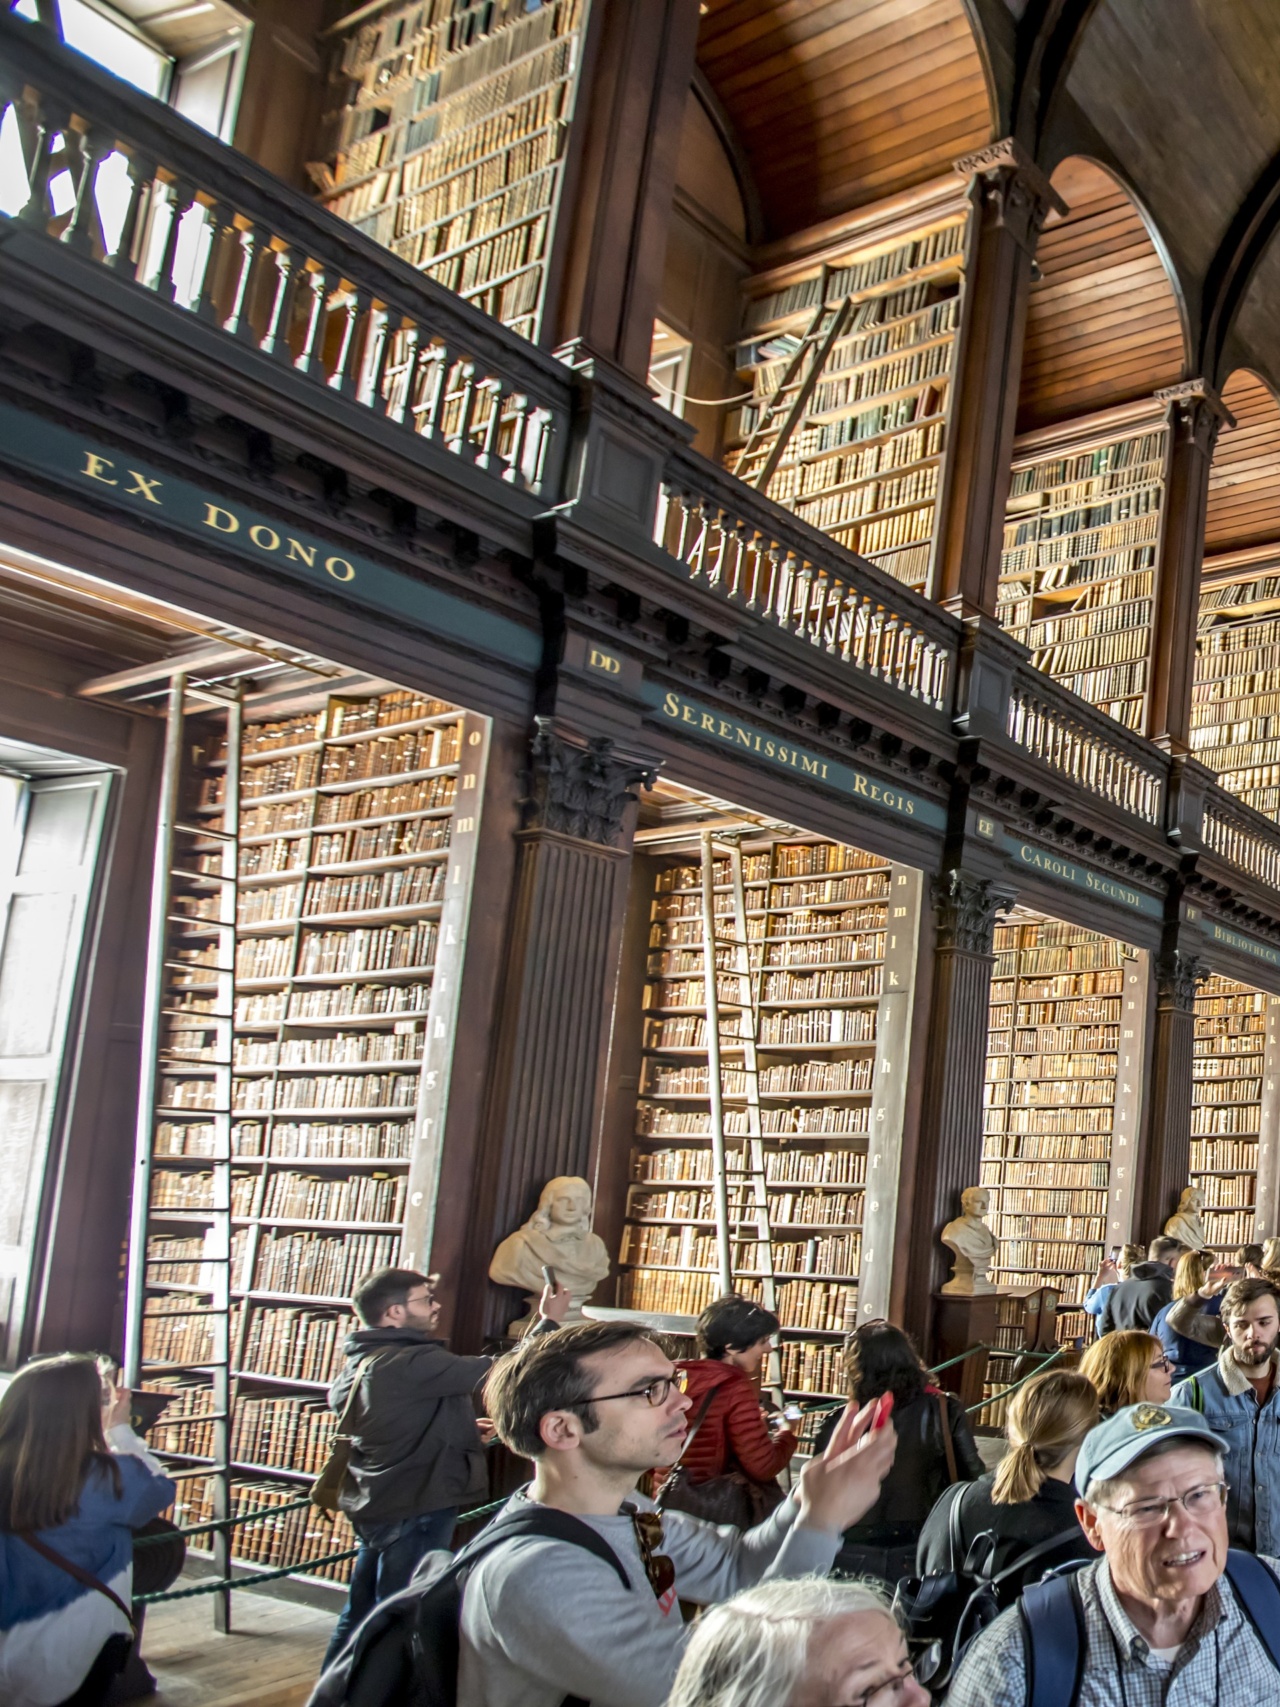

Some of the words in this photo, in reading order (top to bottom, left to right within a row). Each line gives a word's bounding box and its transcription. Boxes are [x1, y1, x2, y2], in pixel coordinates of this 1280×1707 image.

[80, 450, 163, 505] EX
[204, 502, 356, 583] DONO
[590, 650, 620, 675] DD
[469, 733, 481, 746] o
[662, 691, 829, 780] SERENISSIMI
[853, 772, 916, 816] REGIS
[462, 772, 476, 790] n
[456, 815, 474, 833] m
[976, 818, 993, 837] EE
[1020, 844, 1076, 880] CAROLI
[898, 874, 907, 886] n
[893, 906, 907, 917] m
[444, 924, 456, 945] k
[890, 935, 896, 949] l
[1214, 926, 1278, 963] BIBLIOTHECA
[439, 972, 446, 992] i
[888, 972, 899, 986] k
[1129, 975, 1138, 984] o
[1127, 1001, 1135, 1010] n
[884, 1007, 891, 1022] i
[432, 1016, 445, 1039] h
[1124, 1030, 1134, 1038] m
[1270, 1034, 1276, 1044] k
[880, 1059, 890, 1073] h
[425, 1069, 438, 1091] g
[1266, 1080, 1274, 1090] h
[1122, 1083, 1132, 1093] k
[876, 1108, 886, 1122] g
[1120, 1109, 1126, 1120] i
[420, 1117, 432, 1140] f
[1118, 1134, 1127, 1146] h
[872, 1154, 882, 1168] f
[1116, 1166, 1126, 1178] g
[411, 1190, 424, 1207] e
[1114, 1189, 1122, 1201] f
[870, 1201, 880, 1212] e
[1112, 1221, 1120, 1230] e
[1258, 1220, 1266, 1231] d
[864, 1248, 874, 1262] d
[864, 1303, 873, 1314] c
